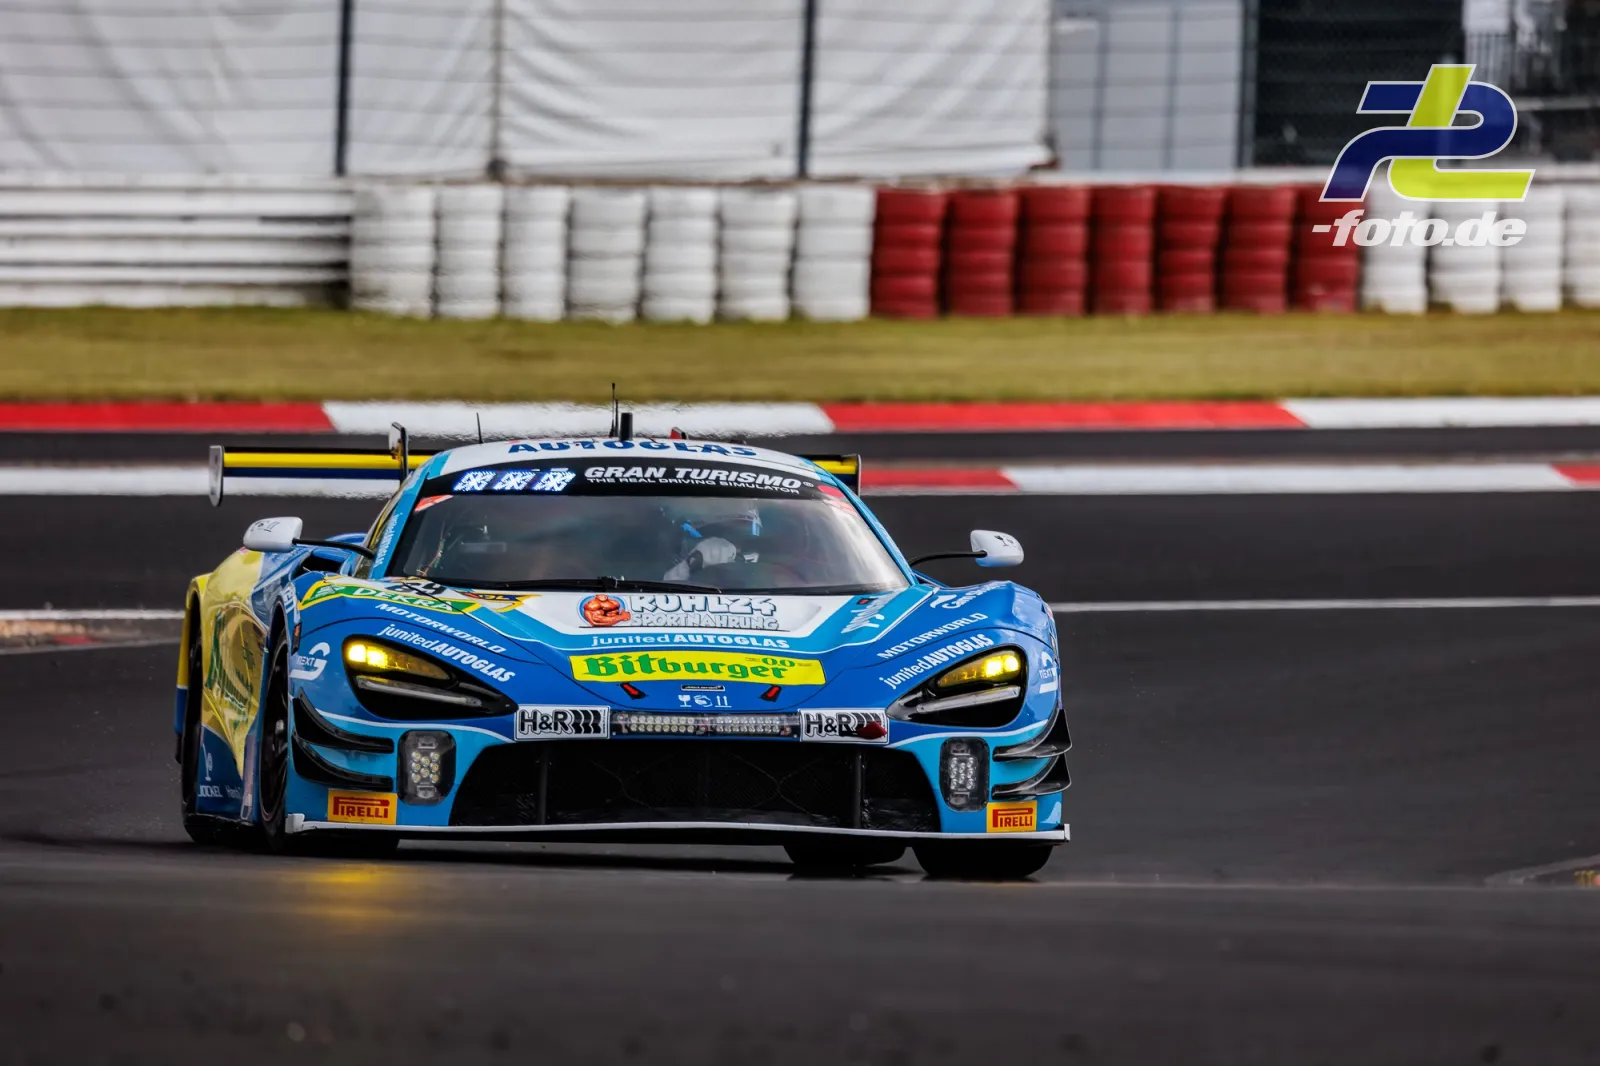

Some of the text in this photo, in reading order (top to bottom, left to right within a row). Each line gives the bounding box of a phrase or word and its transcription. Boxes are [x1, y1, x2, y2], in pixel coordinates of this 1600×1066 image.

[584, 466, 802, 489] GRAN TURISMO
[658, 478, 717, 487] DRIVING
[719, 481, 801, 495] SIMULATOR
[352, 587, 455, 612] DEKRA
[375, 603, 507, 654] MOTORWORLD
[876, 612, 989, 660] MOTORWORLD
[582, 653, 790, 680] Bitburger
[519, 708, 574, 736] H&R
[804, 712, 859, 738] H&R
[333, 795, 391, 819] PIRELLI
[992, 807, 1034, 829] PIRELLI
